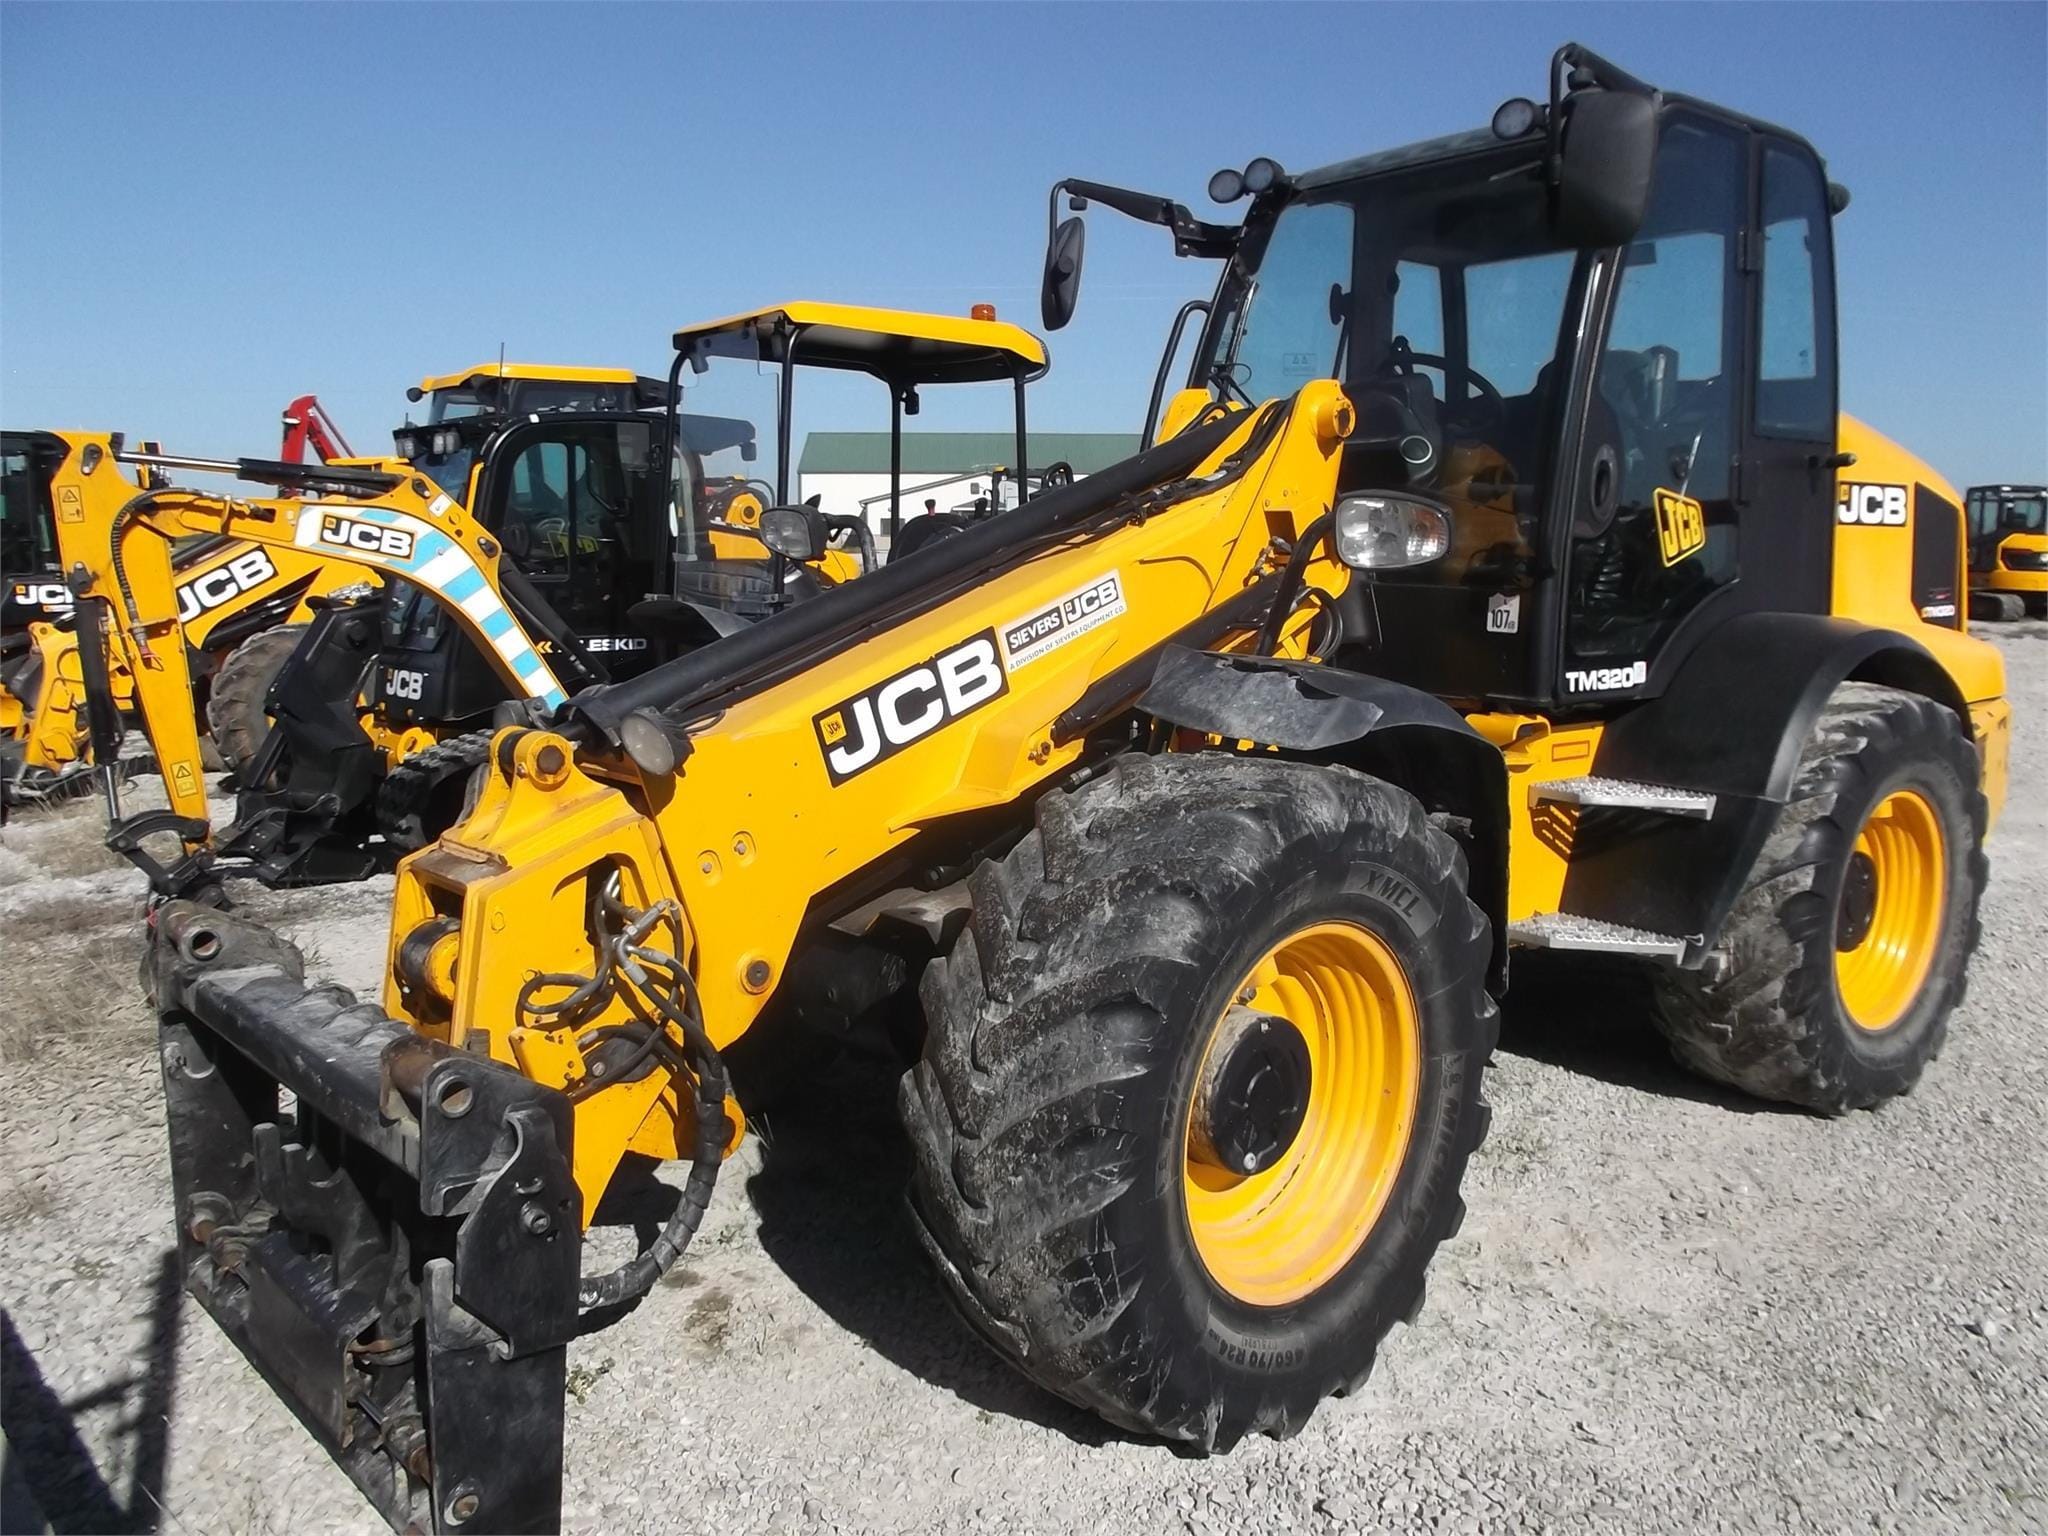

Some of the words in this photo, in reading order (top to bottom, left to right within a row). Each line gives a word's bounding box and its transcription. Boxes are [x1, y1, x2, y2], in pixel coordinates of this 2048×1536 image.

[1663, 497, 1702, 558] JCB
[1839, 484, 1907, 525] JCB
[322, 520, 412, 557] JCB
[178, 550, 275, 624] JCB
[1009, 612, 1061, 649] SIEVERS
[1066, 580, 1118, 619] JCB
[1016, 647, 1045, 667] DIVISION
[1045, 642, 1055, 651] OF
[1055, 629, 1079, 645] SIEVERS
[1080, 611, 1114, 633] EQUIPMENT
[1490, 609, 1510, 629] 107
[386, 669, 423, 700] JCB
[1565, 667, 1635, 693] TM320
[829, 639, 1003, 775] JCB
[1360, 869, 1420, 918] XMCL
